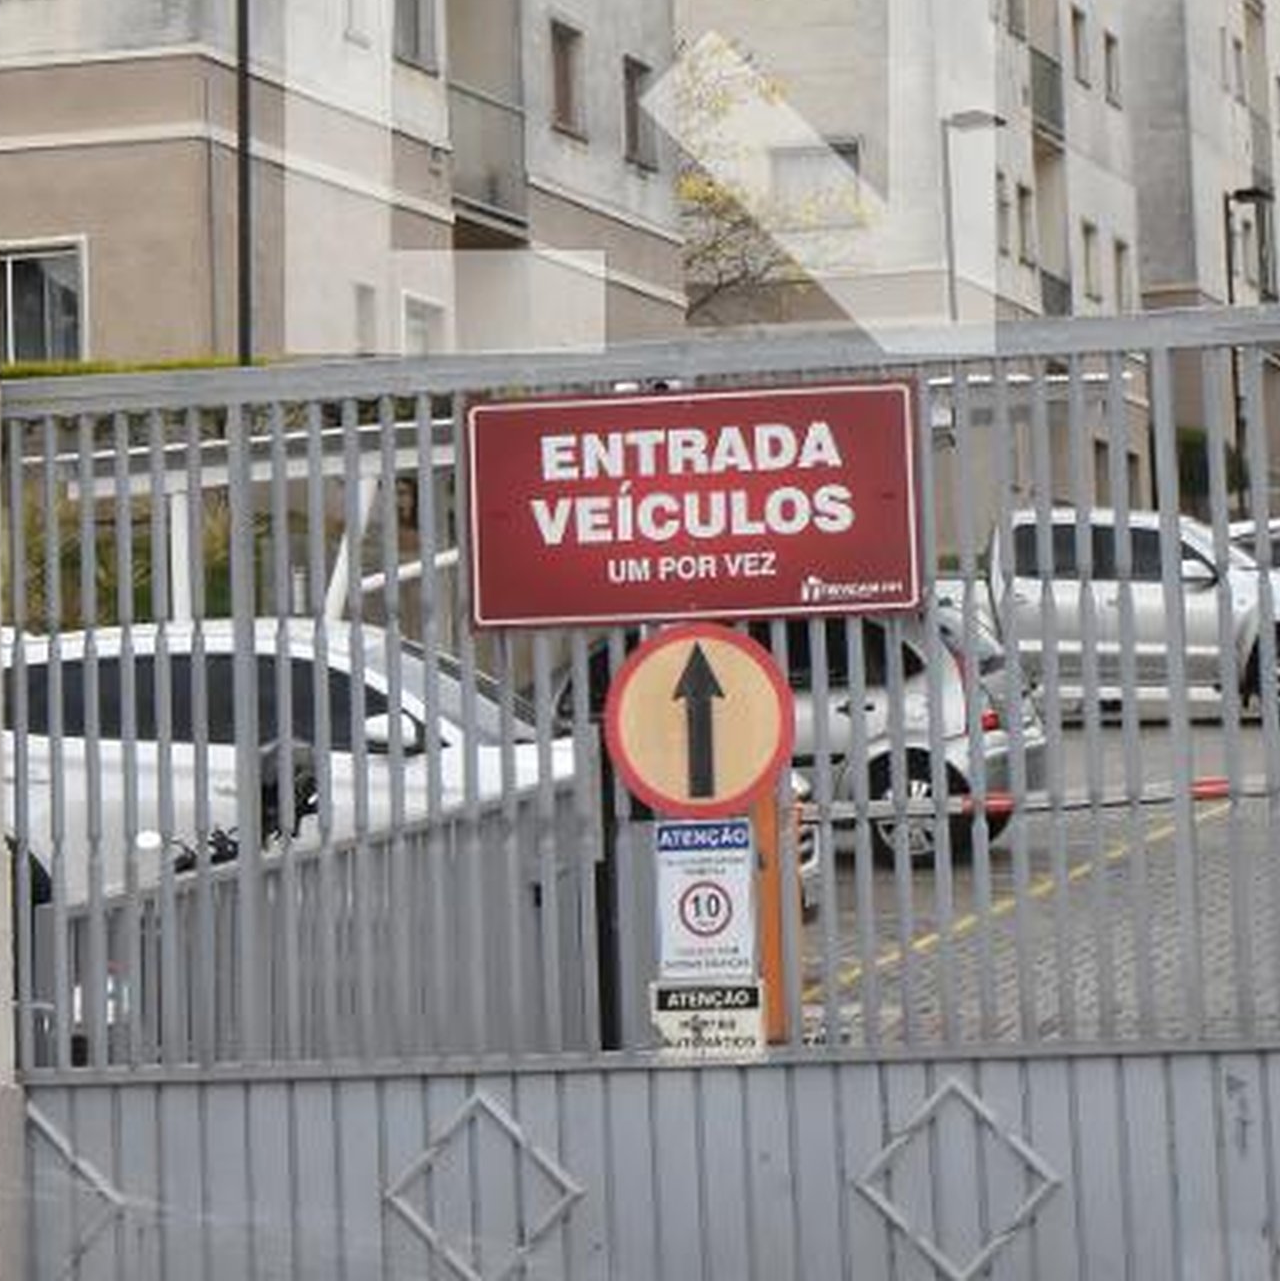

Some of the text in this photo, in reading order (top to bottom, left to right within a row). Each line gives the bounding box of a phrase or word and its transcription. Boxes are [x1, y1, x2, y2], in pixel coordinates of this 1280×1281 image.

[539, 421, 843, 482] ENTRADA
[530, 478, 856, 546] VEÍCULOS
[607, 551, 778, 583] UM POR VEZ
[660, 826, 748, 848] ATENÇÃO
[691, 893, 721, 918] 10
[666, 989, 750, 1009] ATENÇÃO
